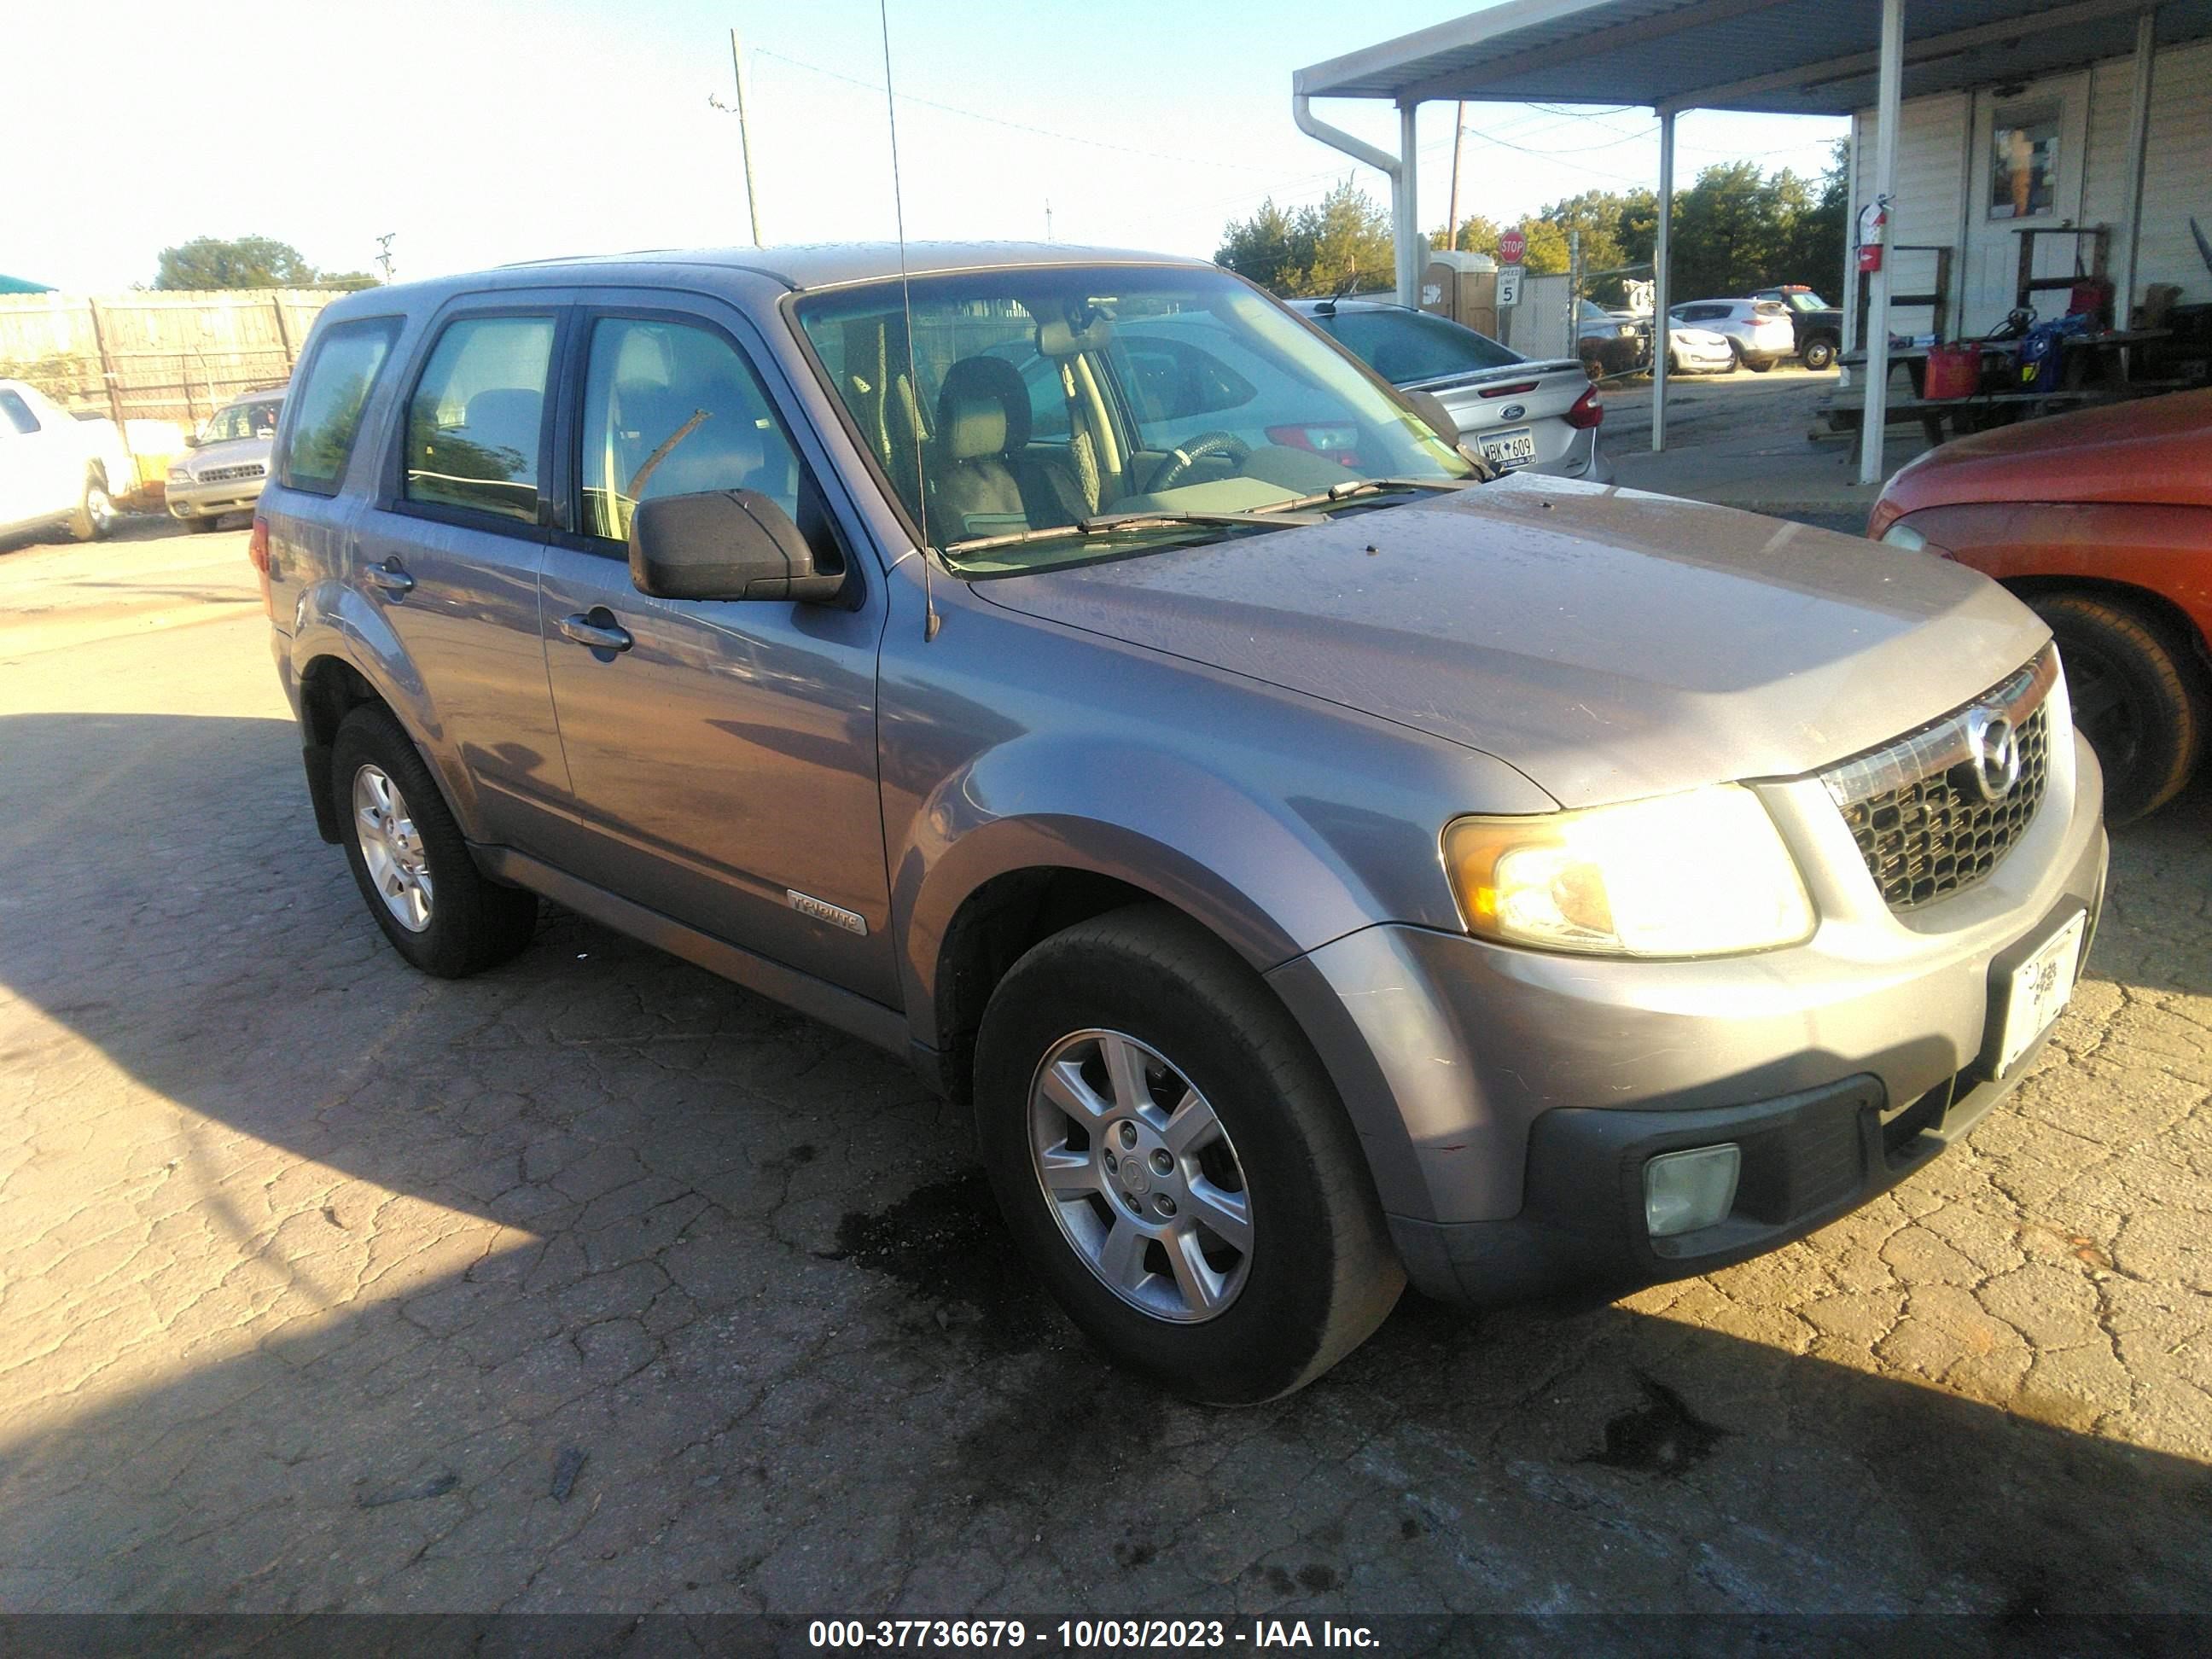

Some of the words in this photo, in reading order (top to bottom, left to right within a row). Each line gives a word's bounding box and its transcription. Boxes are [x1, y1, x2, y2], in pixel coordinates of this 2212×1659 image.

[1502, 241, 1523, 253] STOP
[1503, 287, 1513, 301] 5
[1512, 438, 1531, 457] 609
[791, 895, 862, 933] TRIBUTE
